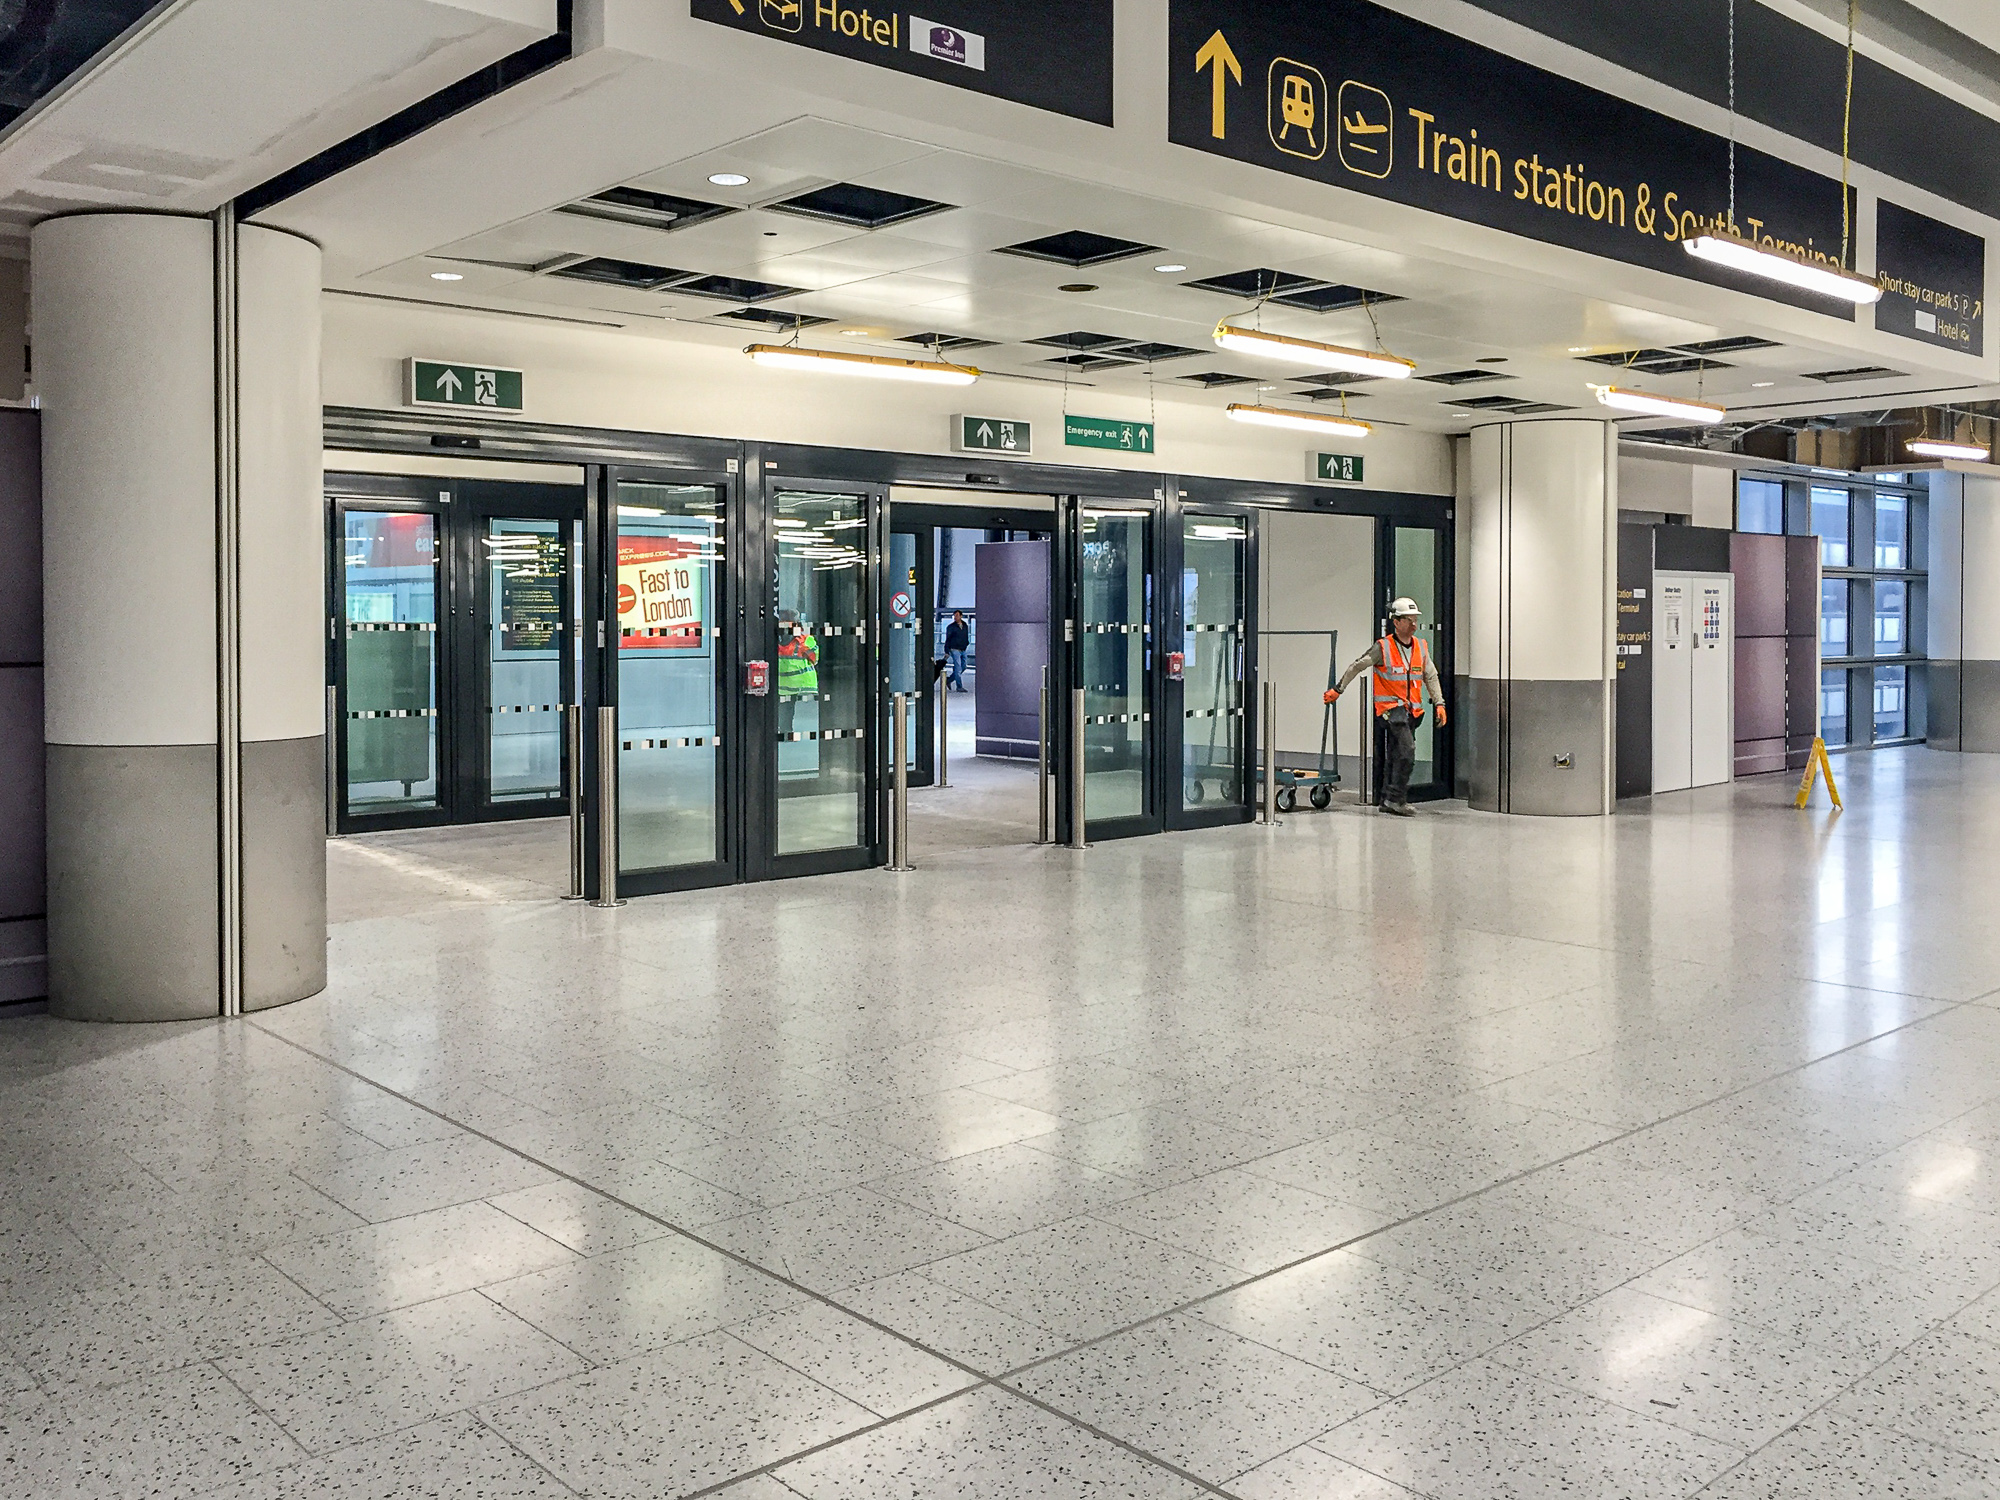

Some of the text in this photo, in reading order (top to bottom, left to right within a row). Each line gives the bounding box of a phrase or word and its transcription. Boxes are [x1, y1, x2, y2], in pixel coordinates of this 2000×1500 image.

[815, 0, 898, 48] Hotel
[931, 43, 965, 59] Premier Inn
[1408, 108, 1502, 192] Train
[1513, 154, 1626, 227] station
[1634, 182, 1656, 236] &
[1879, 270, 1903, 294] Short
[1904, 281, 1921, 303] stay
[1922, 288, 1934, 304] car
[1935, 291, 1953, 309] park
[1937, 318, 1959, 341] Hotel
[1066, 425, 1118, 439] Emergency exit
[638, 567, 690, 594] Fast to
[642, 593, 693, 623] London
